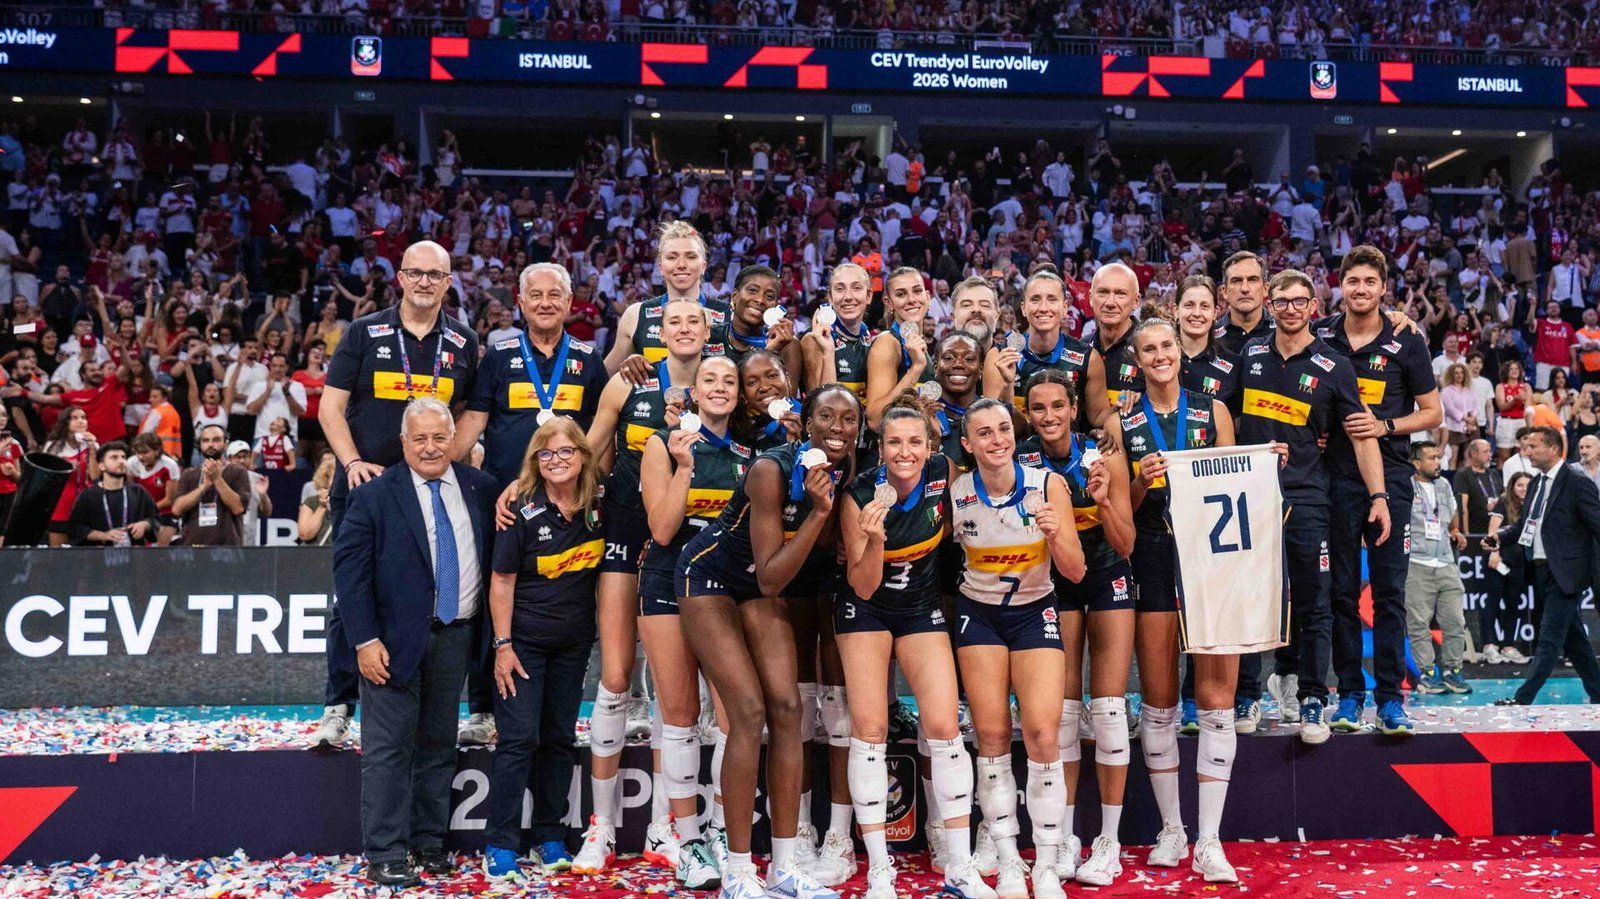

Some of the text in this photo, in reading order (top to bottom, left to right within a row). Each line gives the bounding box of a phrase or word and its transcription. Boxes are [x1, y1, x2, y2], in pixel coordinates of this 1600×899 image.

[519, 53, 592, 69] ISTANBUL
[871, 52, 1049, 74] CEV Trendyol EuroVolley
[913, 73, 1008, 89] 2026 Women
[1458, 77, 1523, 92] ISTANBUL
[1062, 349, 1083, 361] BigMat
[567, 367, 581, 375] ITA
[1369, 362, 1384, 372] ITA
[1120, 374, 1133, 383] ITA
[1203, 386, 1217, 396] ITA
[1298, 384, 1313, 395] ITA
[1187, 409, 1209, 419] BigMat
[1256, 398, 1293, 415] DHL
[1123, 413, 1145, 429] BigMat
[1191, 440, 1207, 448] ITA
[1019, 454, 1041, 463] BigMat
[1191, 455, 1252, 478] OMORUYI
[693, 499, 729, 510] DH
[955, 494, 979, 509] BigMat
[1203, 491, 1252, 554] 21
[605, 542, 628, 561] 24
[981, 552, 1034, 565] DHL
[884, 561, 913, 590] 3
[1000, 576, 1022, 607] 7
[845, 602, 856, 619] 3
[5, 593, 338, 658] CEV TRE
[960, 615, 971, 634] 7
